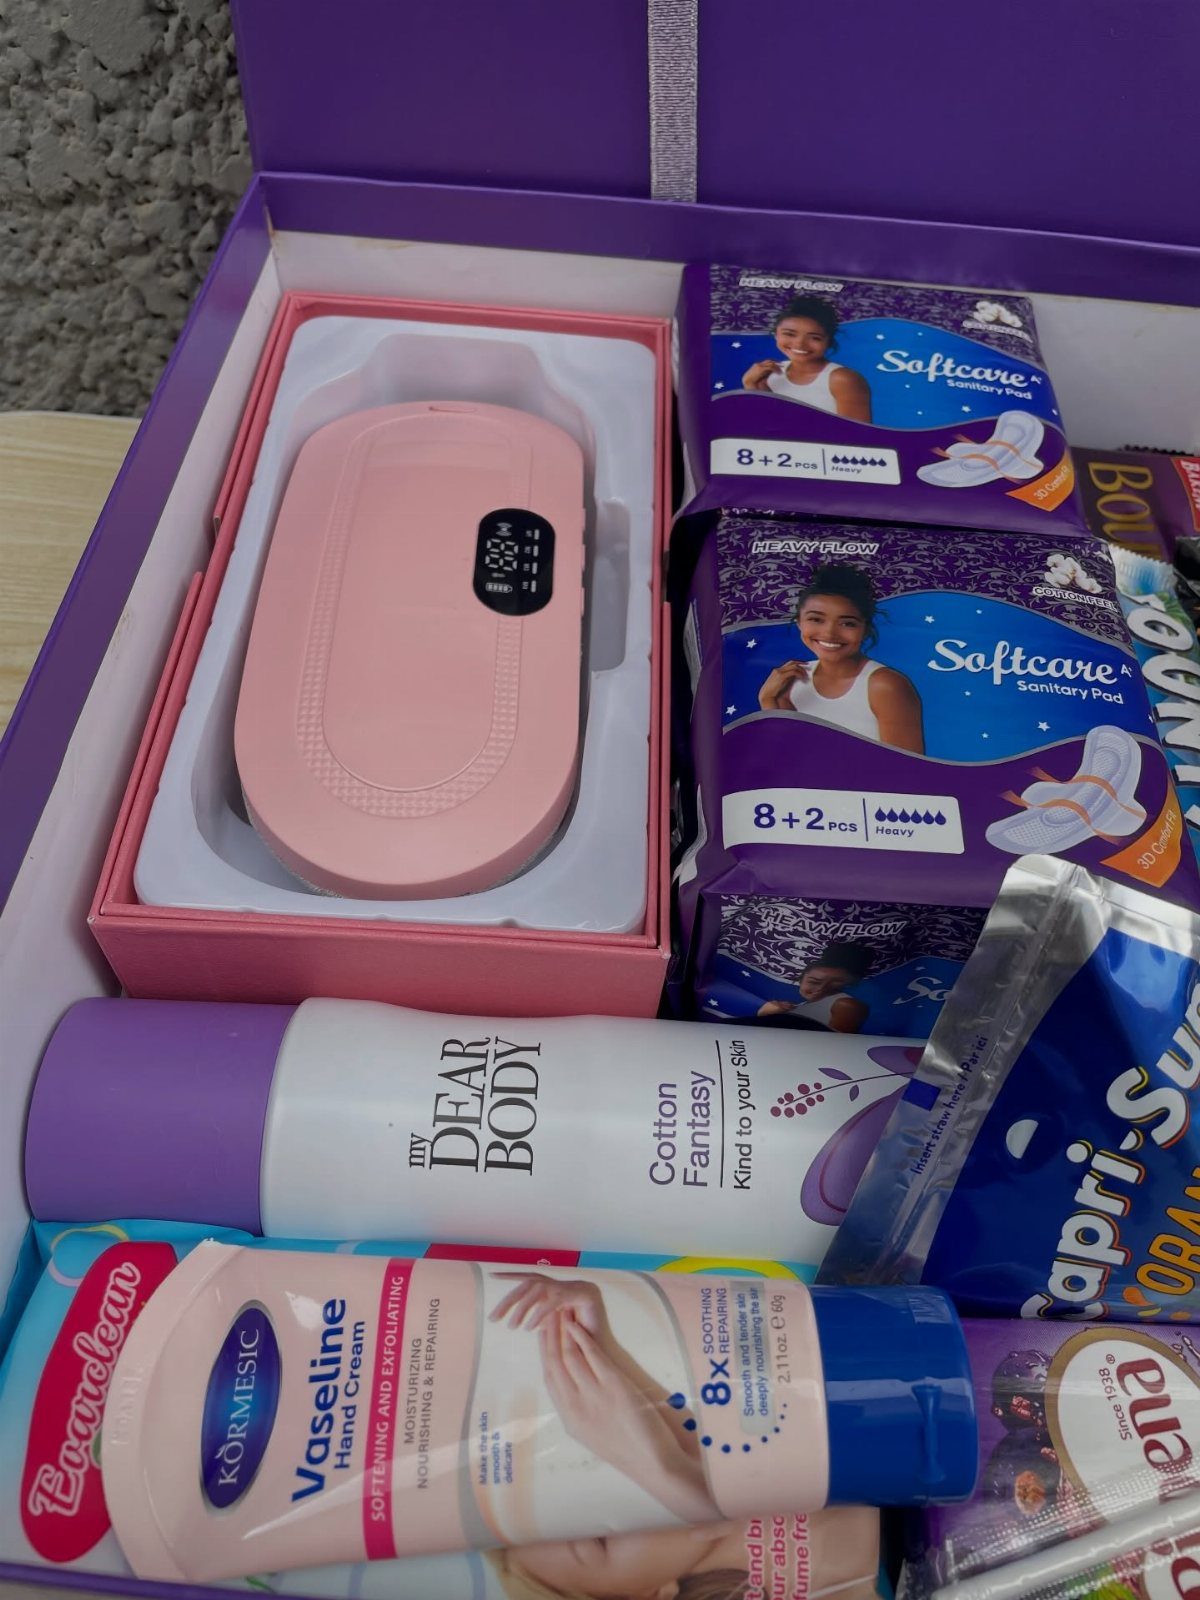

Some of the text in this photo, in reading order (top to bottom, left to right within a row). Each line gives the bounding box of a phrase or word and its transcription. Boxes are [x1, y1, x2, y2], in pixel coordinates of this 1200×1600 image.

[876, 350, 1028, 388] Softcare
[947, 379, 1032, 400] Sanitary Pad
[831, 465, 862, 474] Heavy
[752, 540, 880, 556] HEAVY FLOW
[1033, 586, 1118, 612] COTTON FEEL
[927, 638, 1118, 685] Softcare
[1017, 680, 1124, 704] Sanitary Pad
[828, 822, 858, 832] PCS
[876, 826, 914, 837] Heavy
[1137, 852, 1156, 870] 3D
[1151, 821, 1174, 855] Comfort
[761, 909, 908, 937] HEAVY FLOW
[429, 1037, 491, 1172] DEAR
[484, 1035, 541, 1176] BODY
[731, 1040, 756, 1190] Kind to your Skin
[910, 1142, 936, 1174] Insert
[931, 1111, 951, 1140] straw
[942, 1084, 966, 1109] here
[960, 1052, 980, 1073] Par
[972, 1035, 989, 1059] ici
[408, 1132, 433, 1168] my
[649, 1082, 677, 1186] Cotton
[683, 1070, 716, 1187] Fantasy
[1136, 1166, 1200, 1296] ORA
[701, 1288, 714, 1354] SOOTHING
[716, 1288, 730, 1354] REPAIRING
[738, 1311, 748, 1342] tender
[750, 1301, 760, 1315] the
[771, 1295, 786, 1312] 60g
[741, 1344, 750, 1366] and
[752, 1316, 764, 1372] nourishing
[291, 1298, 346, 1502] Vaseline
[334, 1321, 366, 1469] Hand Cream
[371, 1276, 404, 1521] SOFTENING AND EXFOLIATING
[404, 1338, 423, 1443] MOISTURIZING
[418, 1298, 441, 1488] NOURISHING & REPAIRING
[741, 1369, 754, 1416] Smooth
[756, 1377, 768, 1416] deeply
[1099, 1367, 1132, 1440] Since 1938
[479, 1411, 487, 1485] Make the skin
[492, 1442, 500, 1484] smooth
[504, 1441, 513, 1483] delicate
[747, 1544, 762, 1586] and
